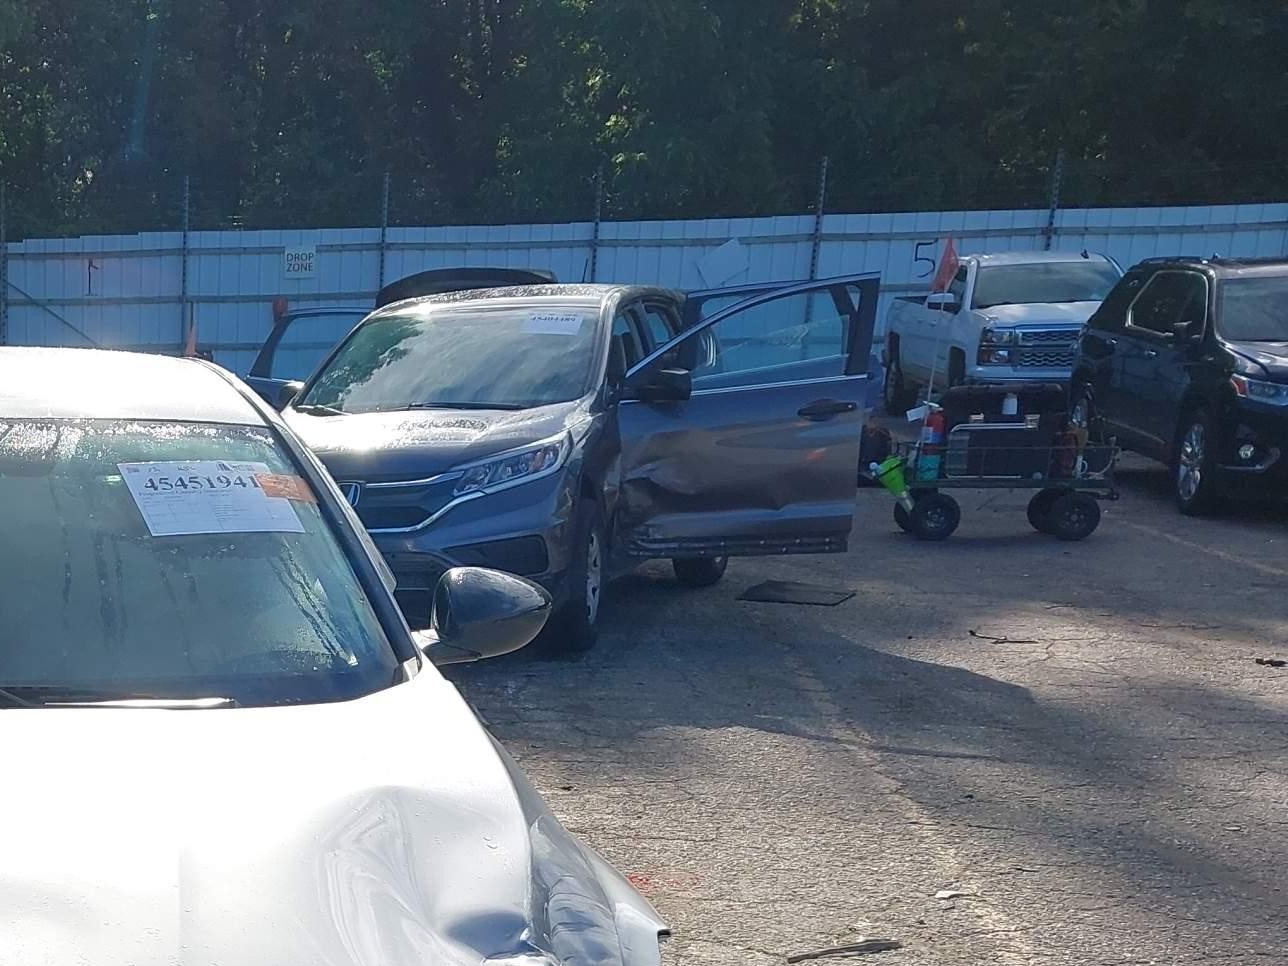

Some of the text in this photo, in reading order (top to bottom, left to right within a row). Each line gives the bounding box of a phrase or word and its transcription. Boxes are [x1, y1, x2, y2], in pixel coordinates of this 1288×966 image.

[286, 252, 314, 262] DROP
[914, 237, 939, 279] 5
[286, 262, 313, 272] ZONE
[144, 475, 261, 491] 45451941
